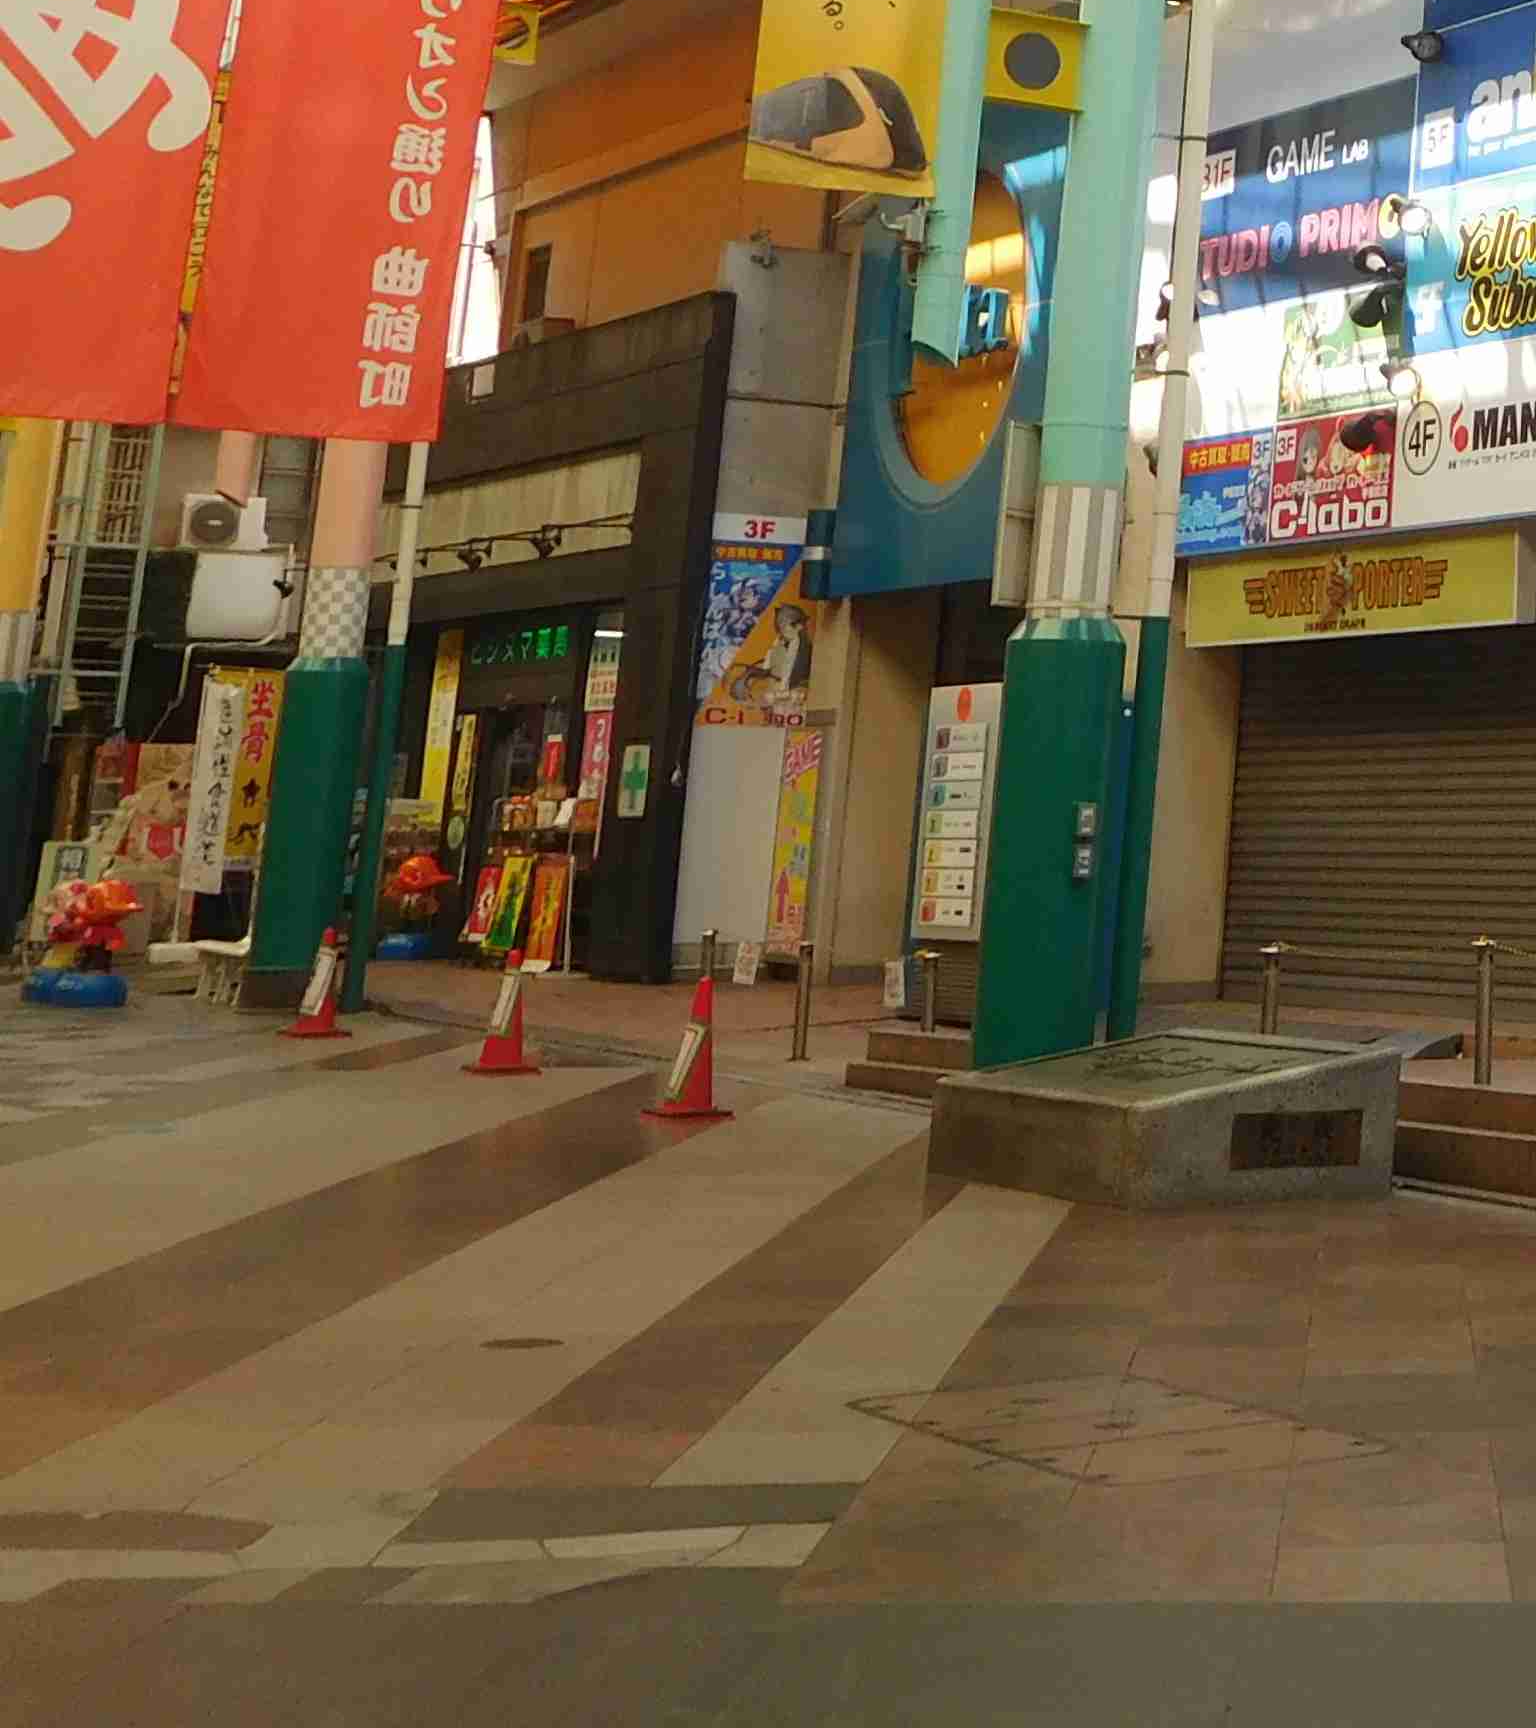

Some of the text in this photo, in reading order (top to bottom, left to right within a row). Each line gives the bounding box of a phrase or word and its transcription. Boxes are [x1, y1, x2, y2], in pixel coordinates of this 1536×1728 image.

[1266, 129, 1369, 184] GAME LAB
[1200, 222, 1293, 281] TUDIO
[1254, 439, 1271, 458] 3F
[1278, 435, 1295, 457] 3F
[1408, 418, 1437, 458] 4F
[744, 520, 777, 540] 3F
[1351, 556, 1425, 611] PORTER
